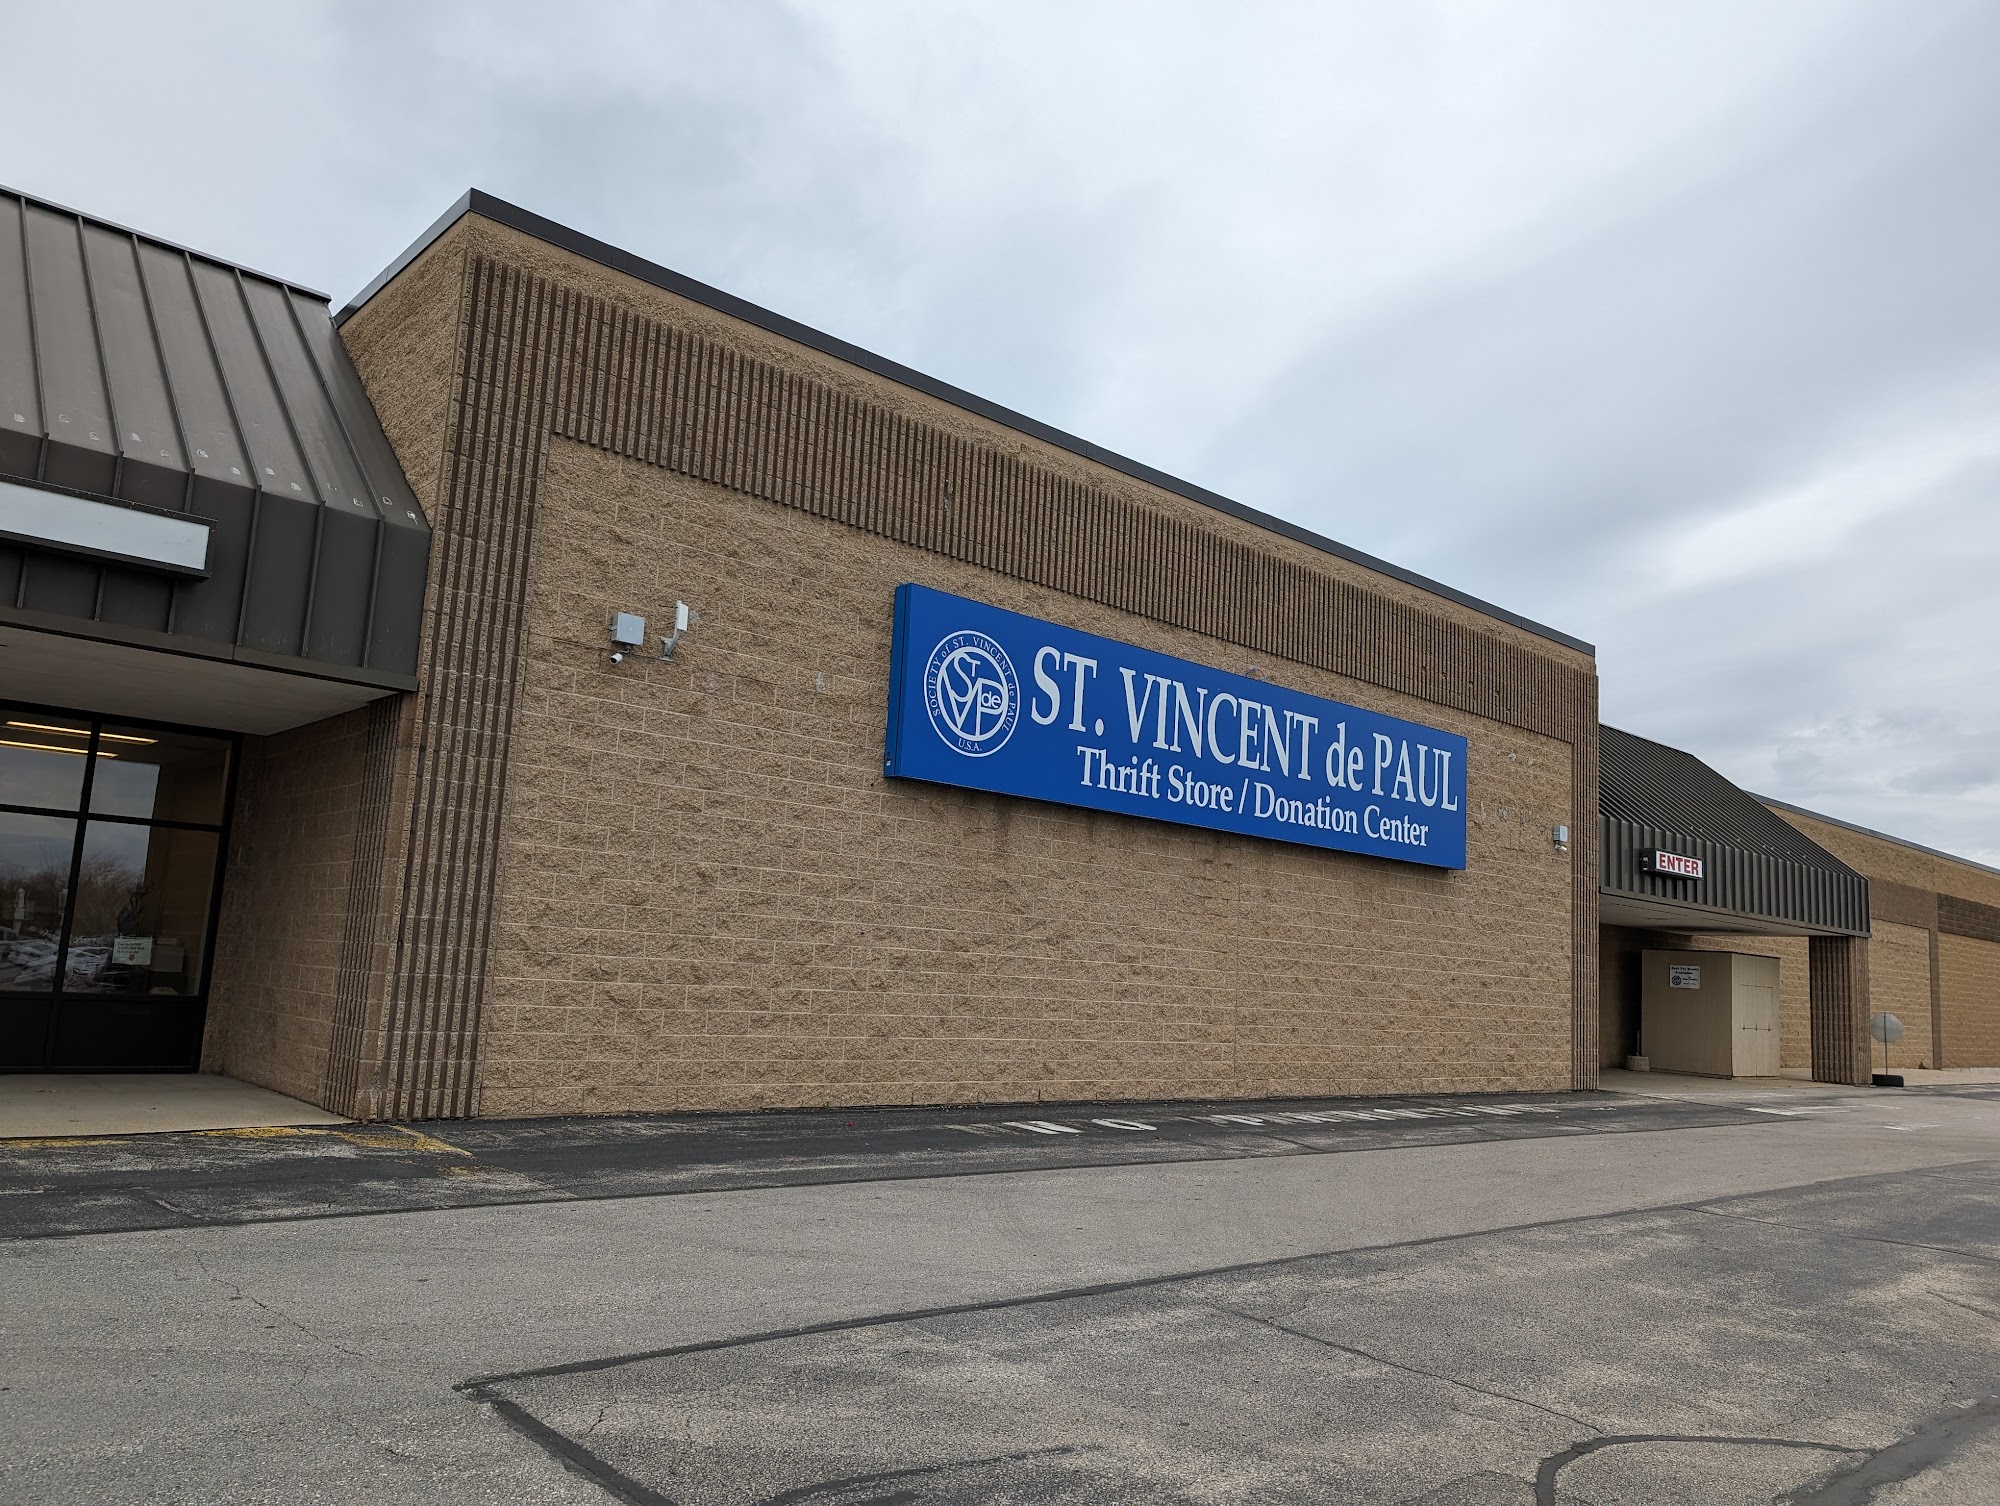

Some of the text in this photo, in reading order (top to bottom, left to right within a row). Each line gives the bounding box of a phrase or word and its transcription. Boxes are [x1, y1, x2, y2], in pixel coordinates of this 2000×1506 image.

[928, 636, 1016, 732] SOCIETY of ST. VINCENT de PAUL
[1031, 645, 1459, 812] ST. VINCENT de PAUL
[958, 737, 982, 752] U.S.A.
[1077, 745, 1161, 799] Thrift
[1167, 764, 1234, 813] Store
[1254, 781, 1359, 835] Donation
[1363, 804, 1429, 847] Center
[1659, 853, 1699, 876] ENTER
